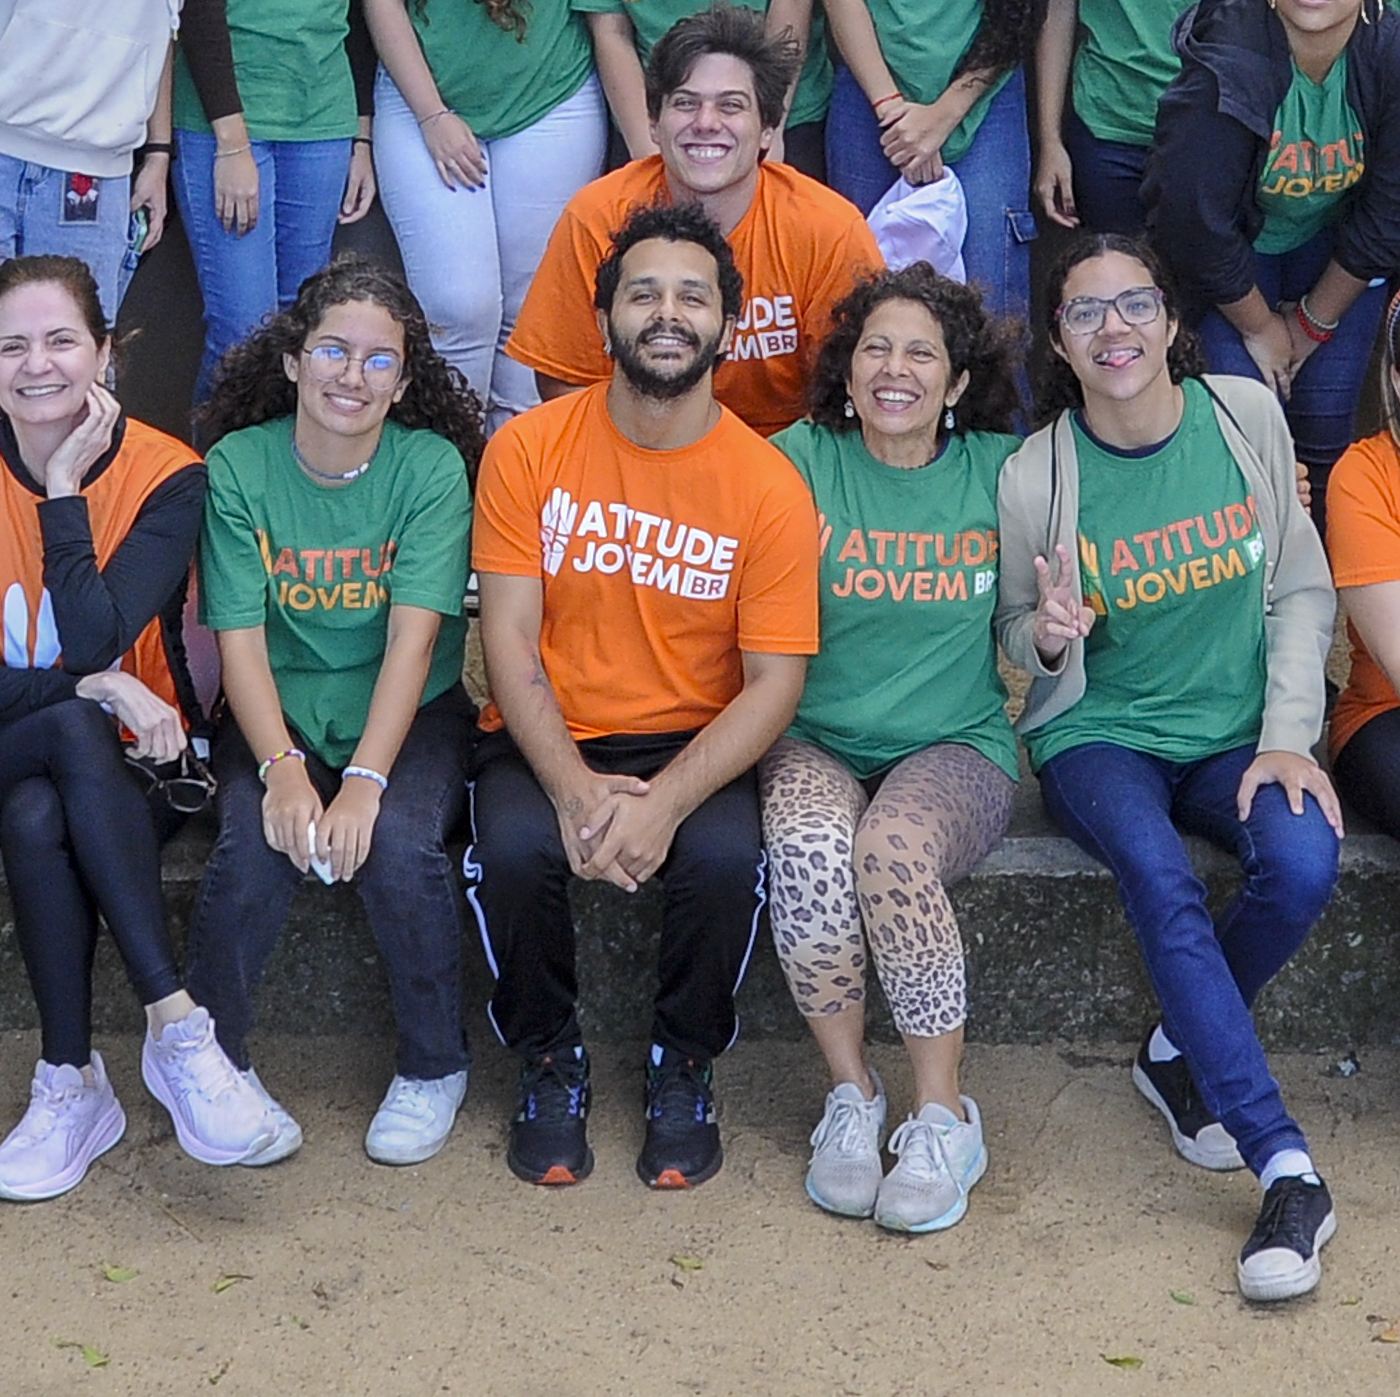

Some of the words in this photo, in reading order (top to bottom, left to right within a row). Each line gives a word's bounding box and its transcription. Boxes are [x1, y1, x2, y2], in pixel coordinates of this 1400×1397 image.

[763, 332, 797, 355] BR
[272, 539, 396, 583] ATITU
[687, 573, 726, 598] BR
[831, 567, 969, 602] JOVEM
[1116, 548, 1247, 611] JOVEM
